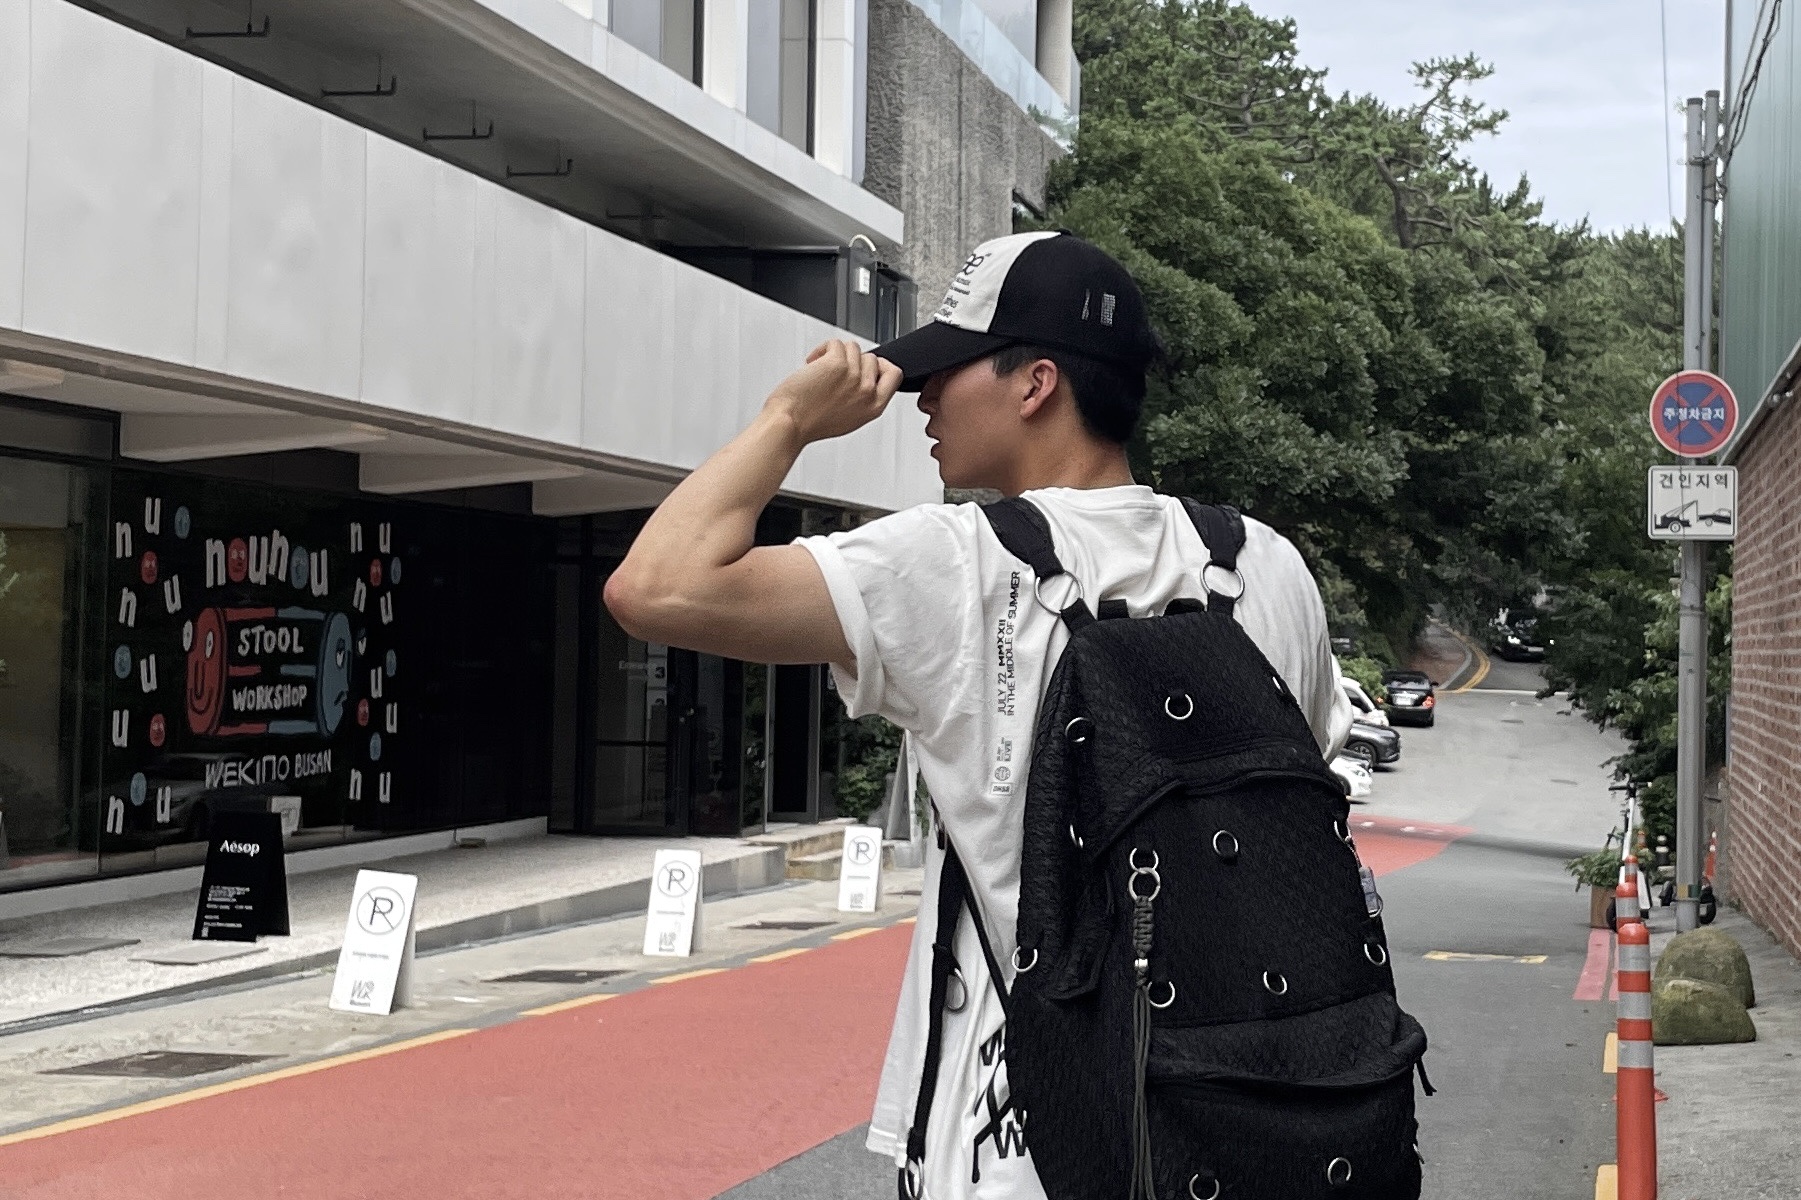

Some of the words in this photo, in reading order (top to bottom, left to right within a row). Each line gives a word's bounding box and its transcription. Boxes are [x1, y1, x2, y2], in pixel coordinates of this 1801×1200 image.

[1663, 407, 1725, 421] 주정차금지
[1659, 473, 1728, 489] 견인지역
[1008, 571, 1020, 619] SUMMER
[1006, 621, 1014, 635] OF
[238, 625, 304, 656] STOOL
[997, 619, 1006, 666] MMXXII
[1005, 637, 1014, 678] MIDDLE
[997, 672, 1006, 684] 22
[232, 684, 307, 712] WORKSHOP
[997, 689, 1006, 715] JULY
[1007, 681, 1015, 703] THE
[1007, 705, 1014, 716] IN
[294, 749, 332, 778] BUSAN
[219, 839, 260, 857] Aesop
